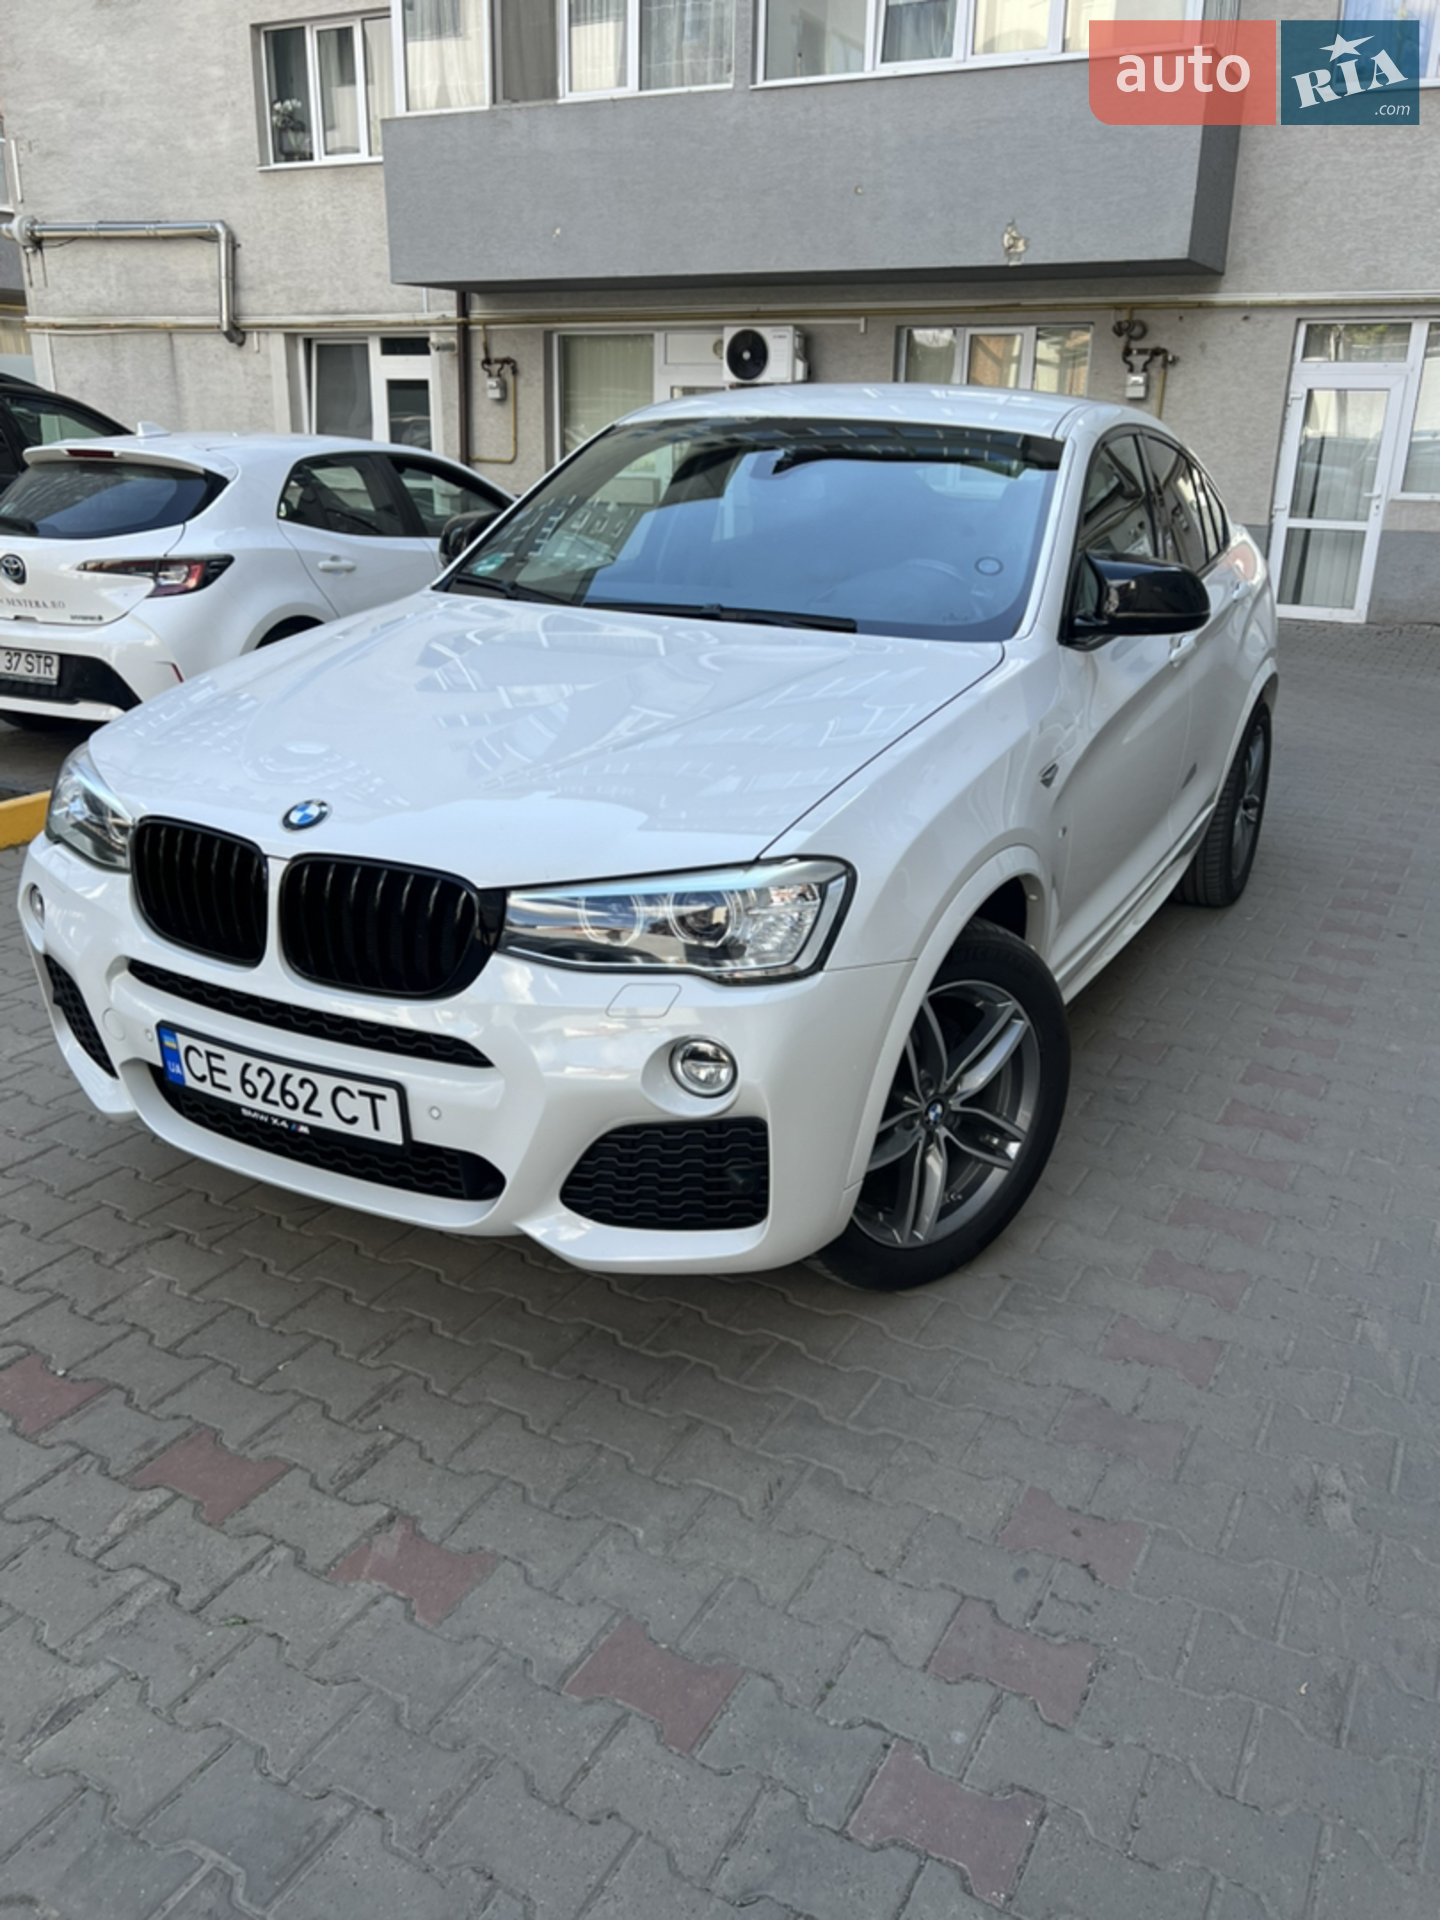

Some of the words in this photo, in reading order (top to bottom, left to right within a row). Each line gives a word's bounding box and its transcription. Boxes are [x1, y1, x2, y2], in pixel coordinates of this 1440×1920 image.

[4, 651, 22, 672] 37
[24, 653, 54, 676] STR
[167, 1060, 182, 1075] UA
[183, 1044, 232, 1093] CE
[239, 1062, 323, 1119] 6262
[330, 1086, 388, 1132] CT
